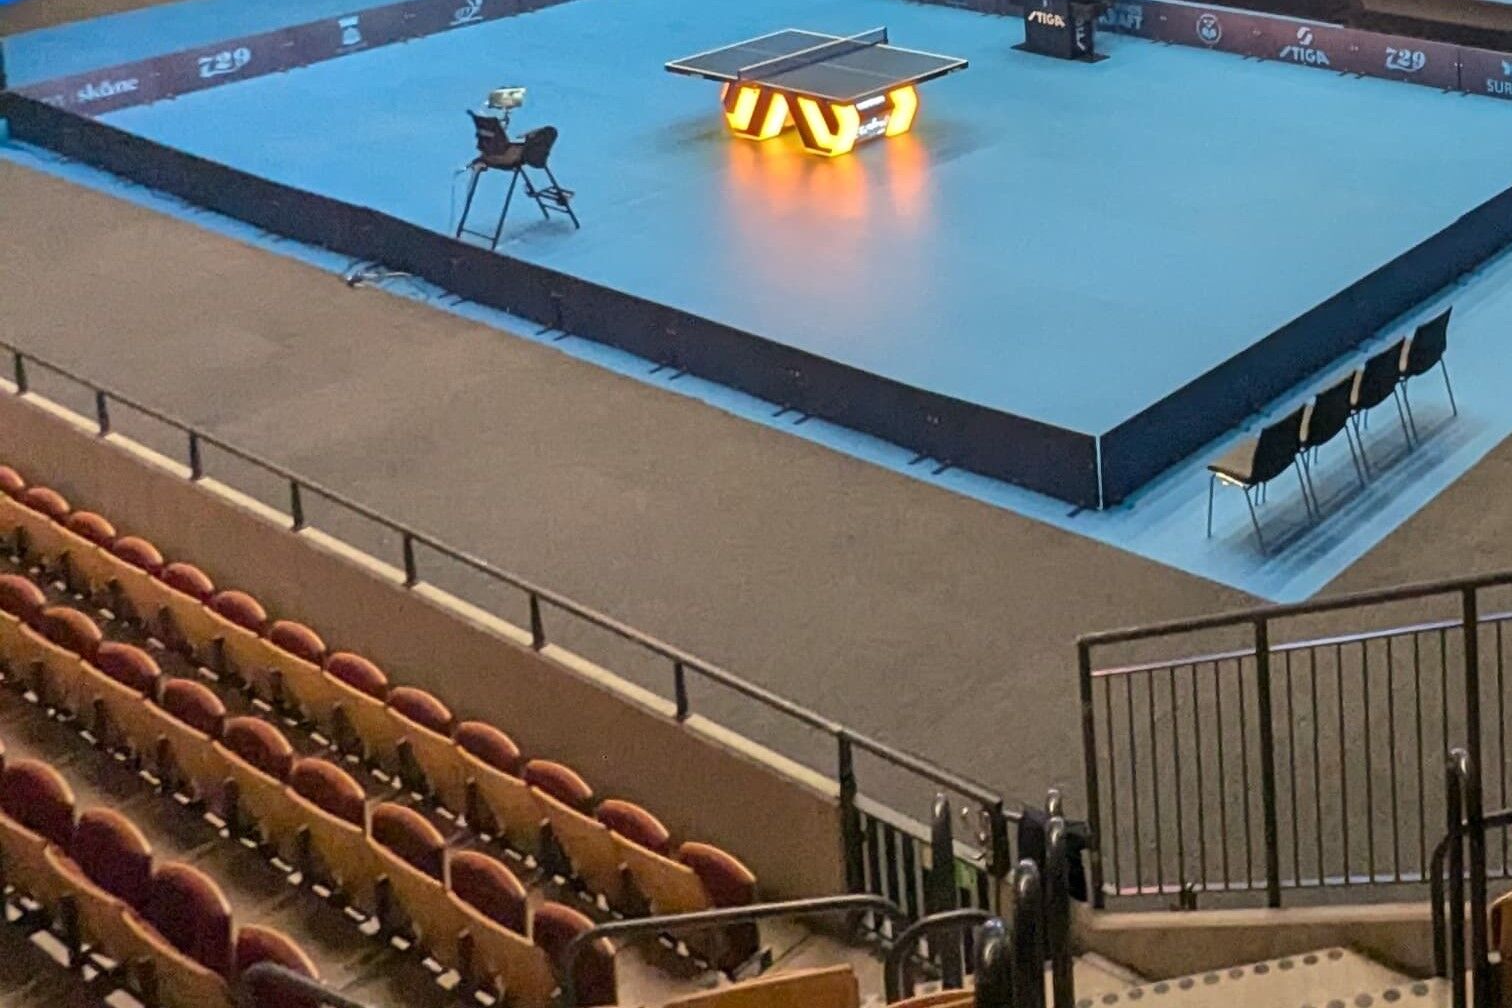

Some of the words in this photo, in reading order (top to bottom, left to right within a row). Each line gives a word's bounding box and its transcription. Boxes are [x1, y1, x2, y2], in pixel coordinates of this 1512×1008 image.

[1028, 10, 1066, 28] STIGA
[199, 46, 251, 77] 729
[1280, 44, 1331, 65] STIGA
[1385, 46, 1427, 73] 729
